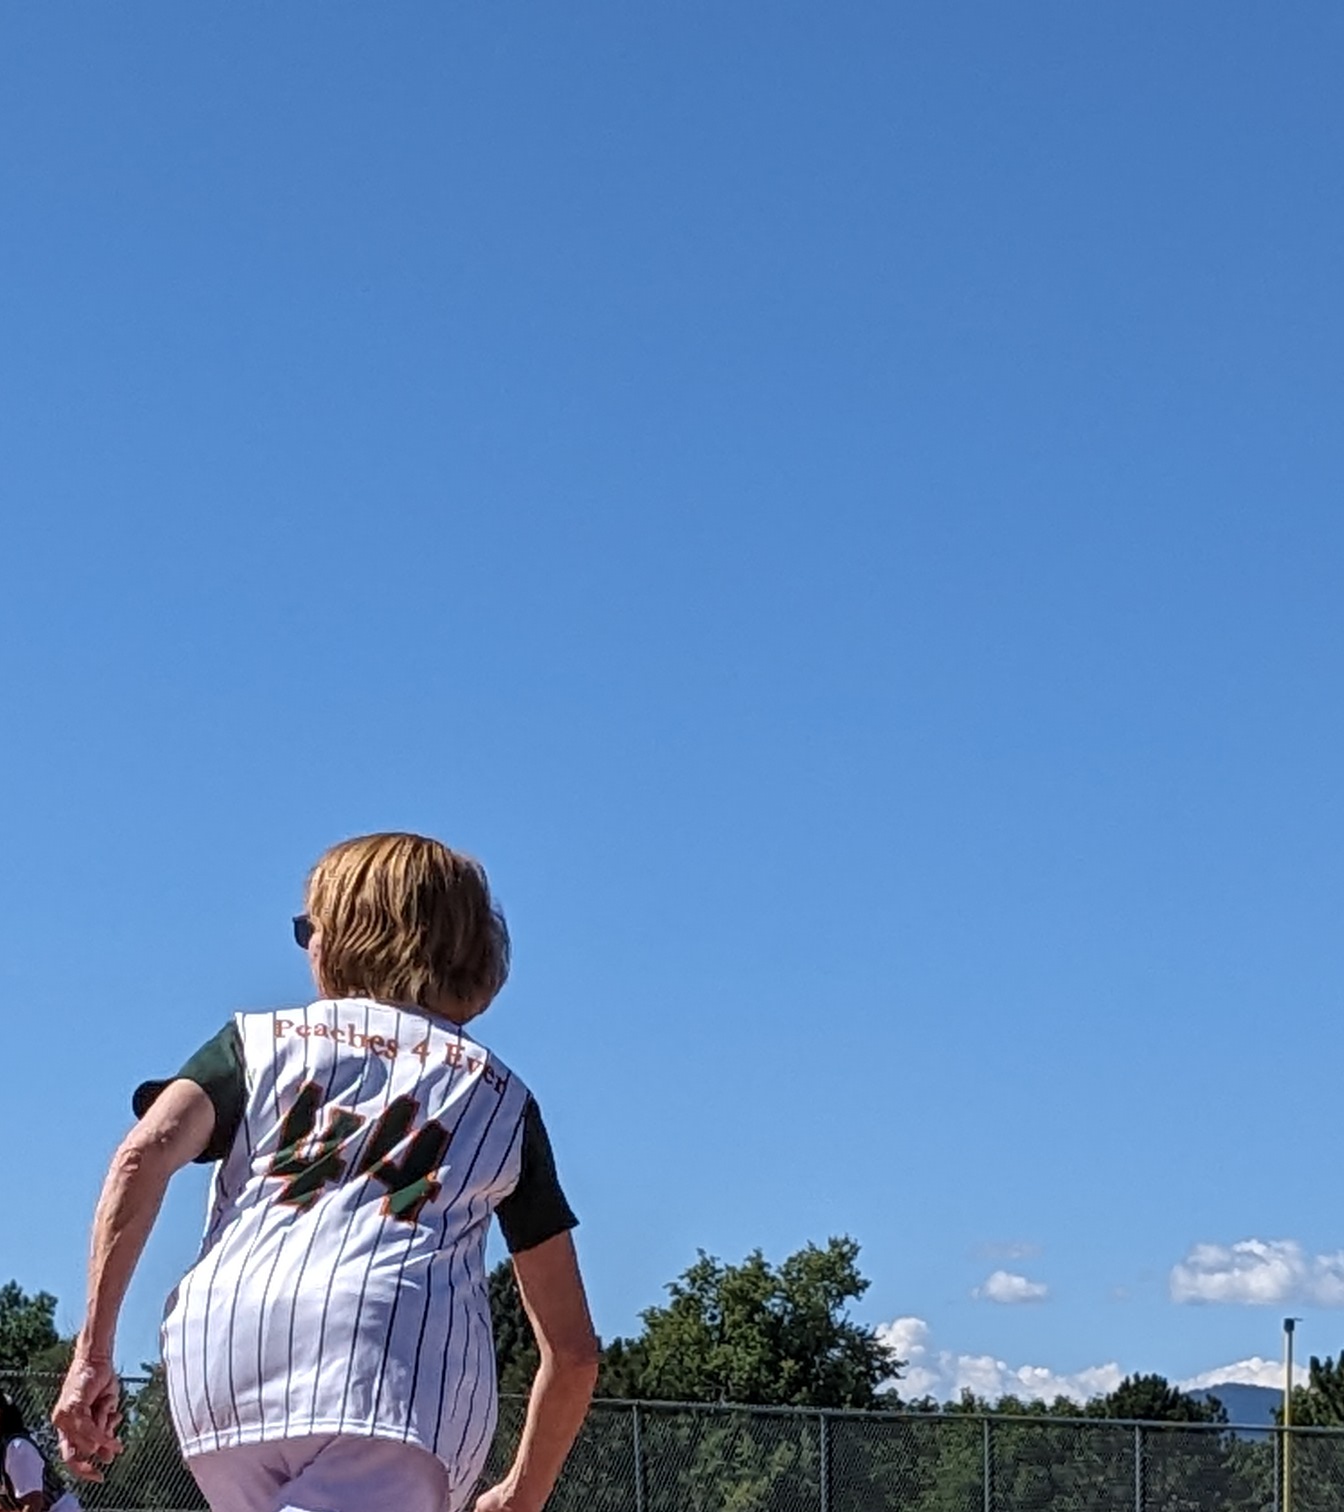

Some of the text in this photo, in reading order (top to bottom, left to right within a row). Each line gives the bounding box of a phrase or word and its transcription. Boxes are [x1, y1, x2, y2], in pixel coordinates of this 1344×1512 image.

[274, 1019, 507, 1094] Peaches 4 Ever
[262, 1080, 451, 1223] 44
